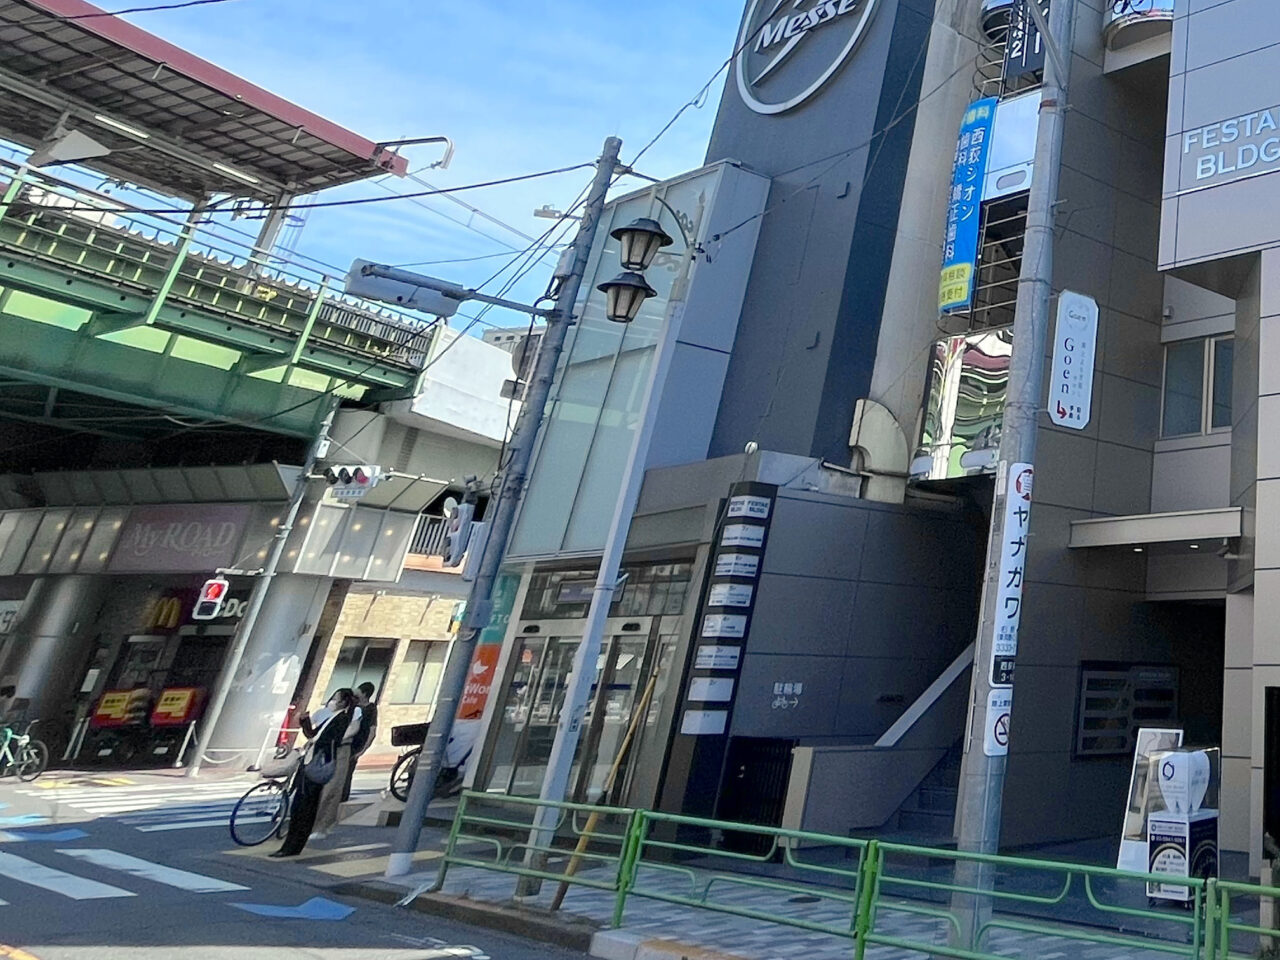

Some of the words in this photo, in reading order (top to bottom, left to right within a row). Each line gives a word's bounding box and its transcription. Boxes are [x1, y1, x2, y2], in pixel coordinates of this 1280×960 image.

[961, 126, 985, 222] 西荻シオン
[1061, 337, 1075, 394] Goen
[1004, 506, 1028, 619] ヤナガワ
